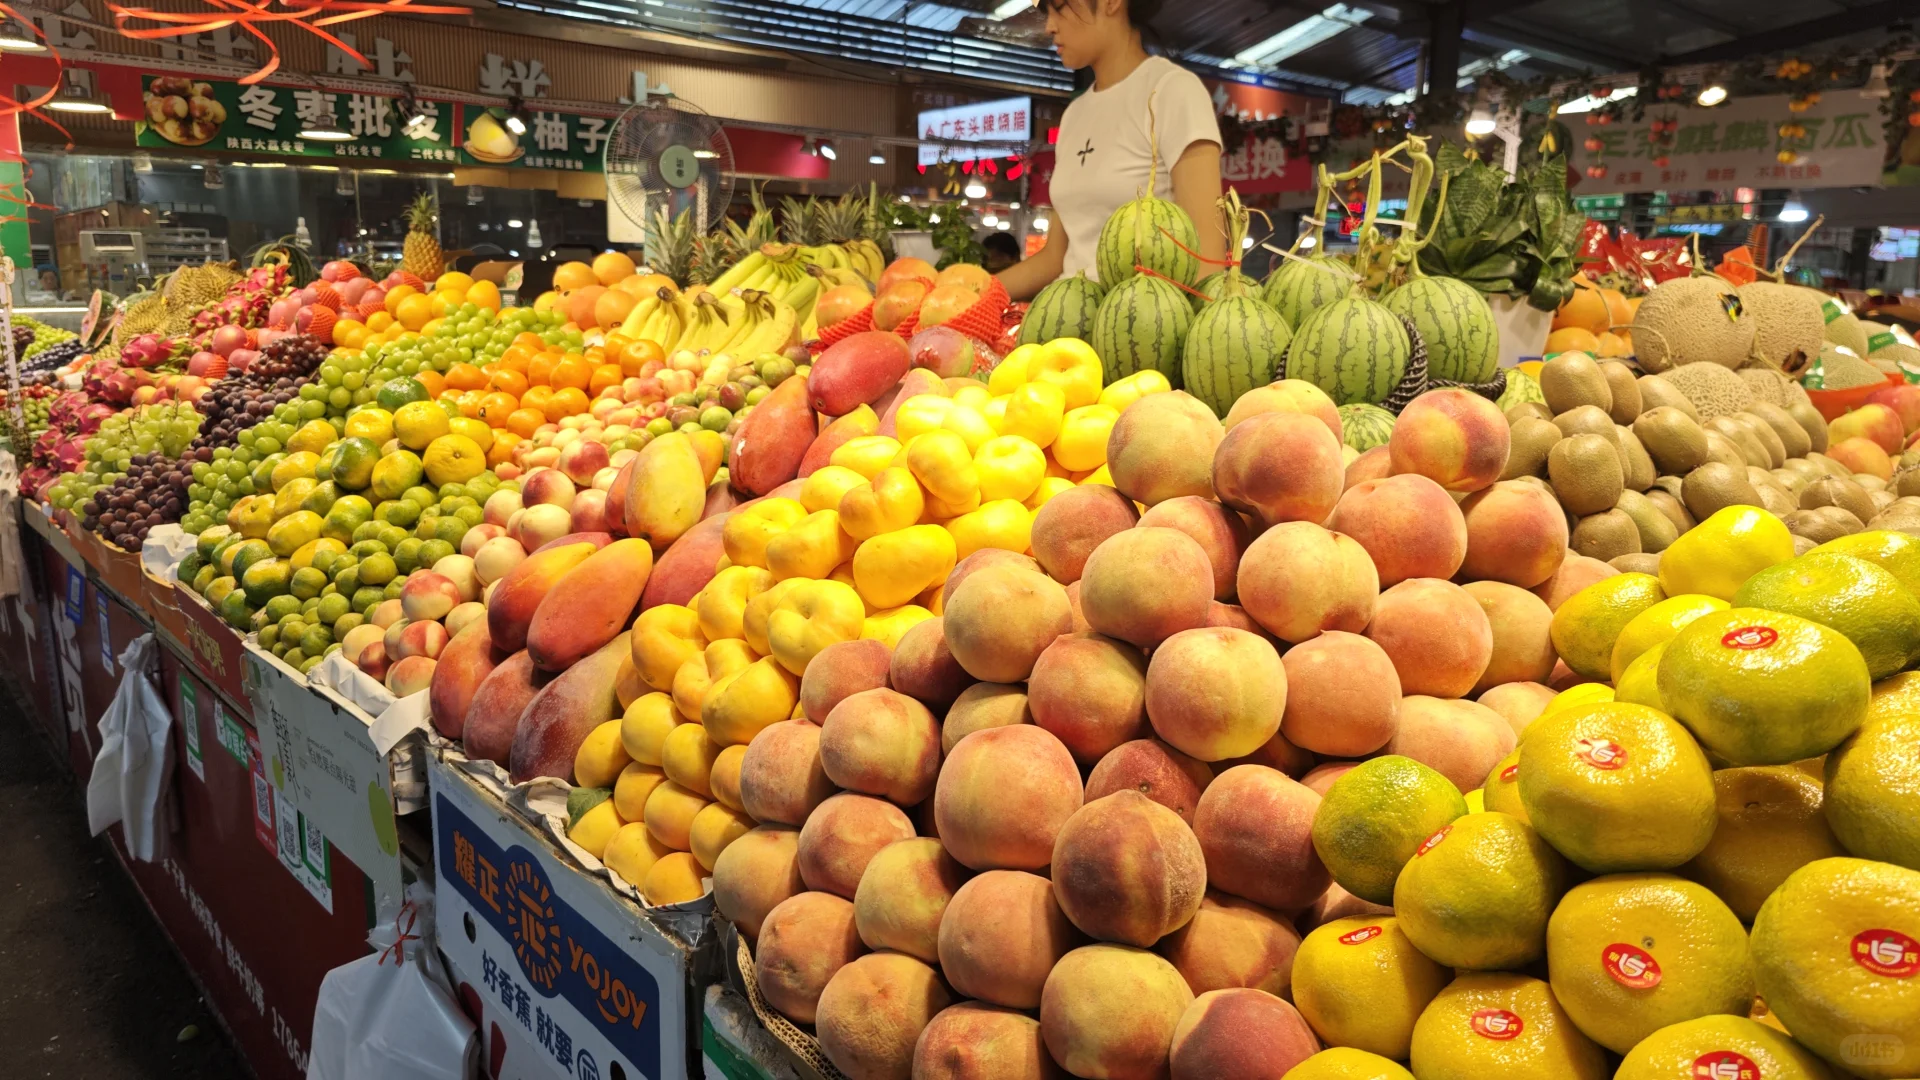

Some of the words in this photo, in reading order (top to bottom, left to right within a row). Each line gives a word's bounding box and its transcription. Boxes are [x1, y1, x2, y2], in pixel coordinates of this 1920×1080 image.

[238, 85, 440, 142] 冬枣批发
[453, 830, 501, 914] 耀正
[482, 949, 532, 1032] 好香蕉
[536, 1005, 574, 1075] 就要
[567, 936, 647, 1030] YOJOY
